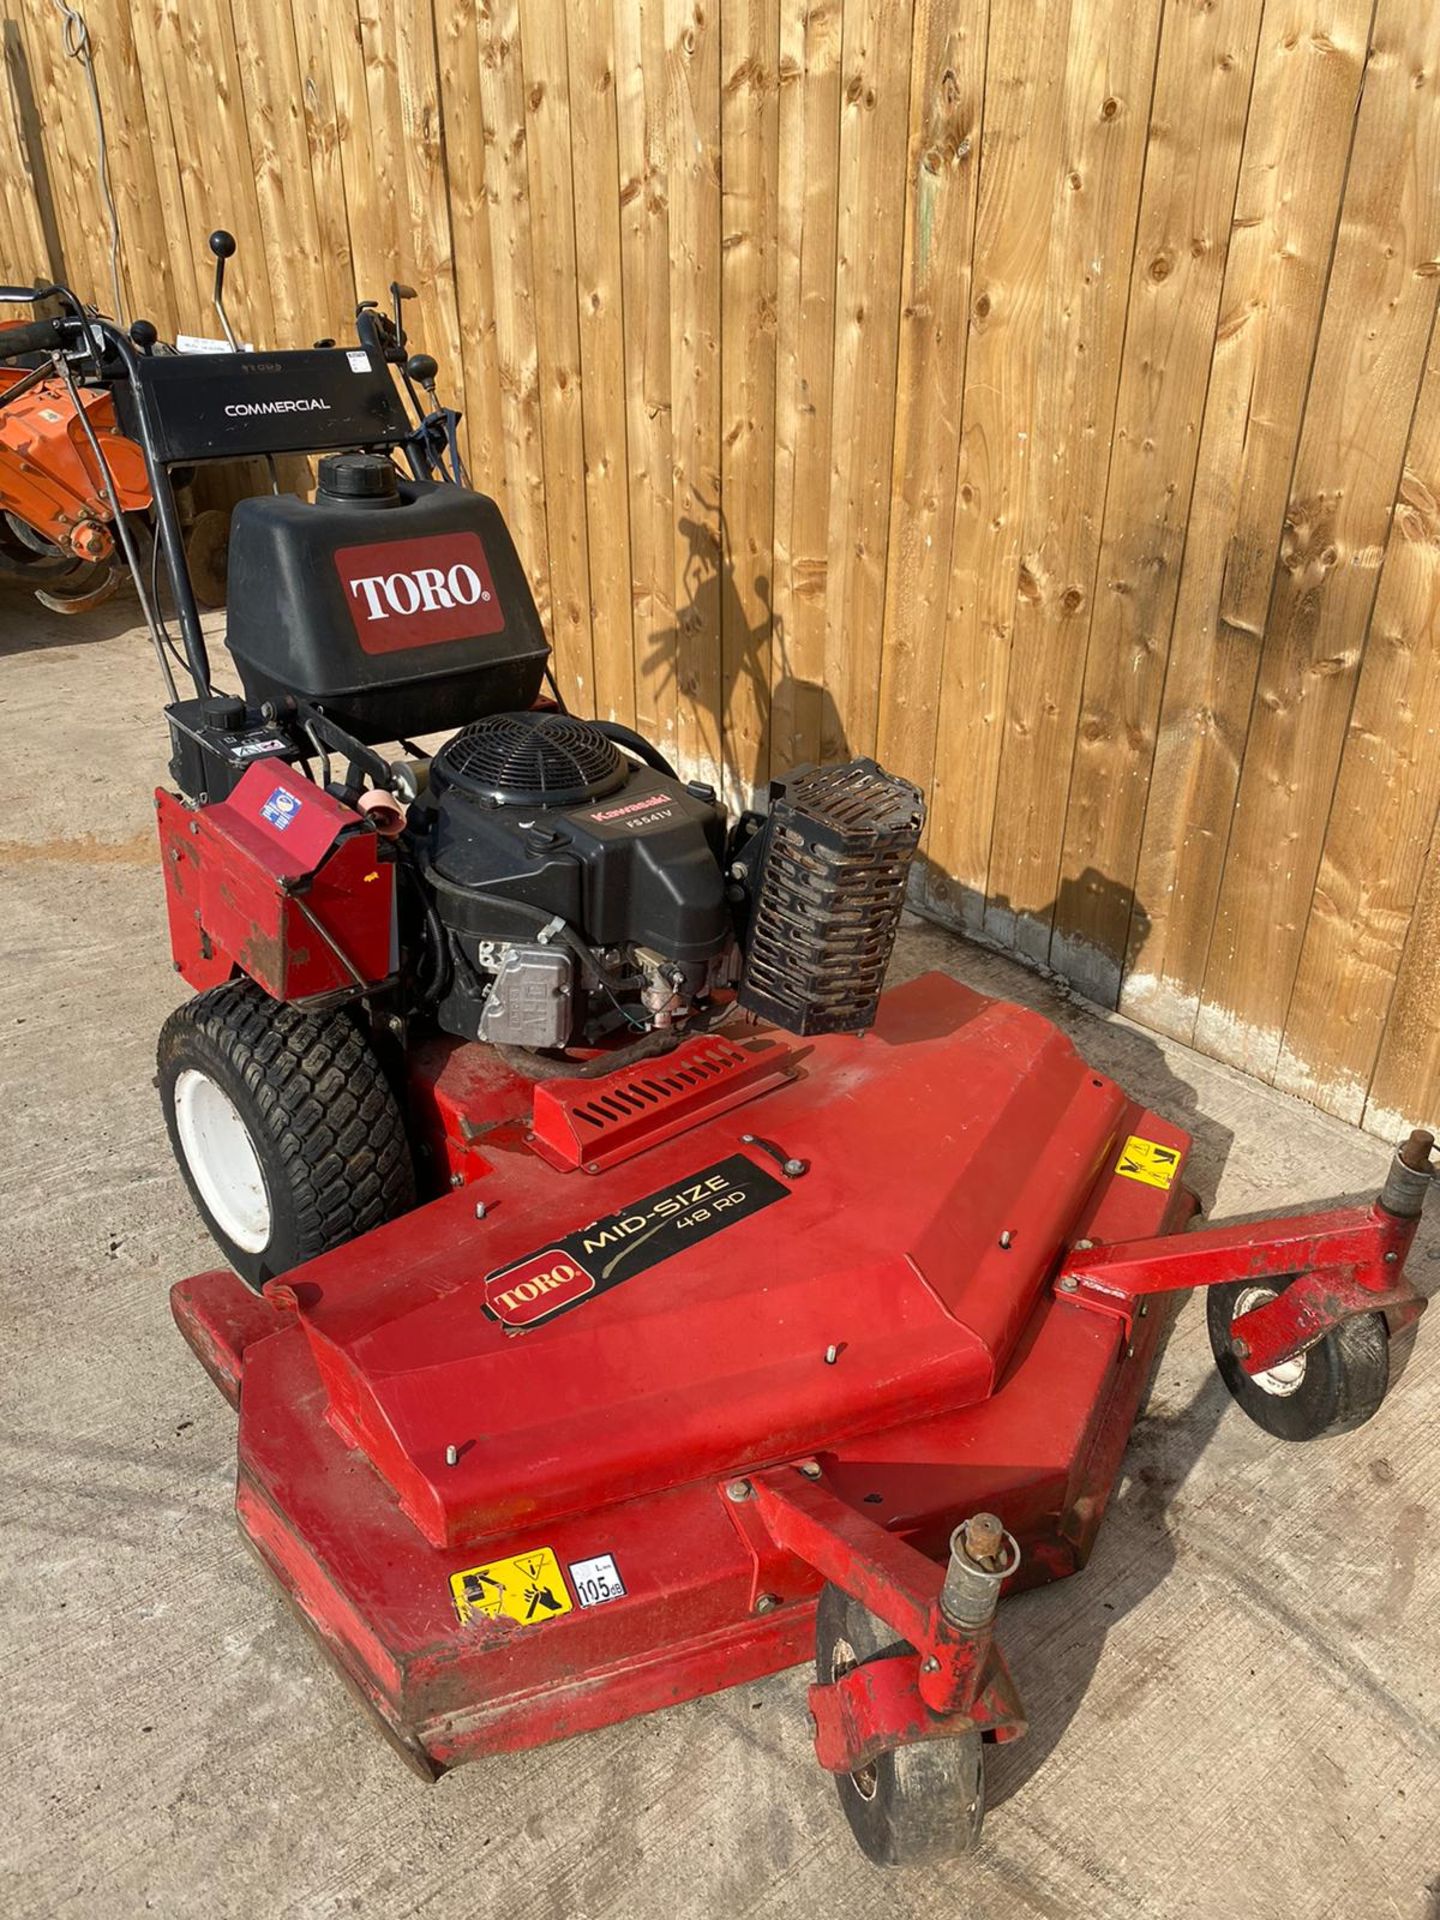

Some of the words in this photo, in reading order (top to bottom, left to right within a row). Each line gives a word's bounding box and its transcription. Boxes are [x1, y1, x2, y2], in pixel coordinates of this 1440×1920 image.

[224, 398, 331, 417] COMMERCIAL
[590, 793, 673, 822] Kawasaki
[625, 809, 673, 829] FS541V
[582, 1174, 731, 1255] MID-SIZE
[676, 1208, 711, 1231] 48
[712, 1190, 747, 1212] RD
[493, 1264, 576, 1312] TORO
